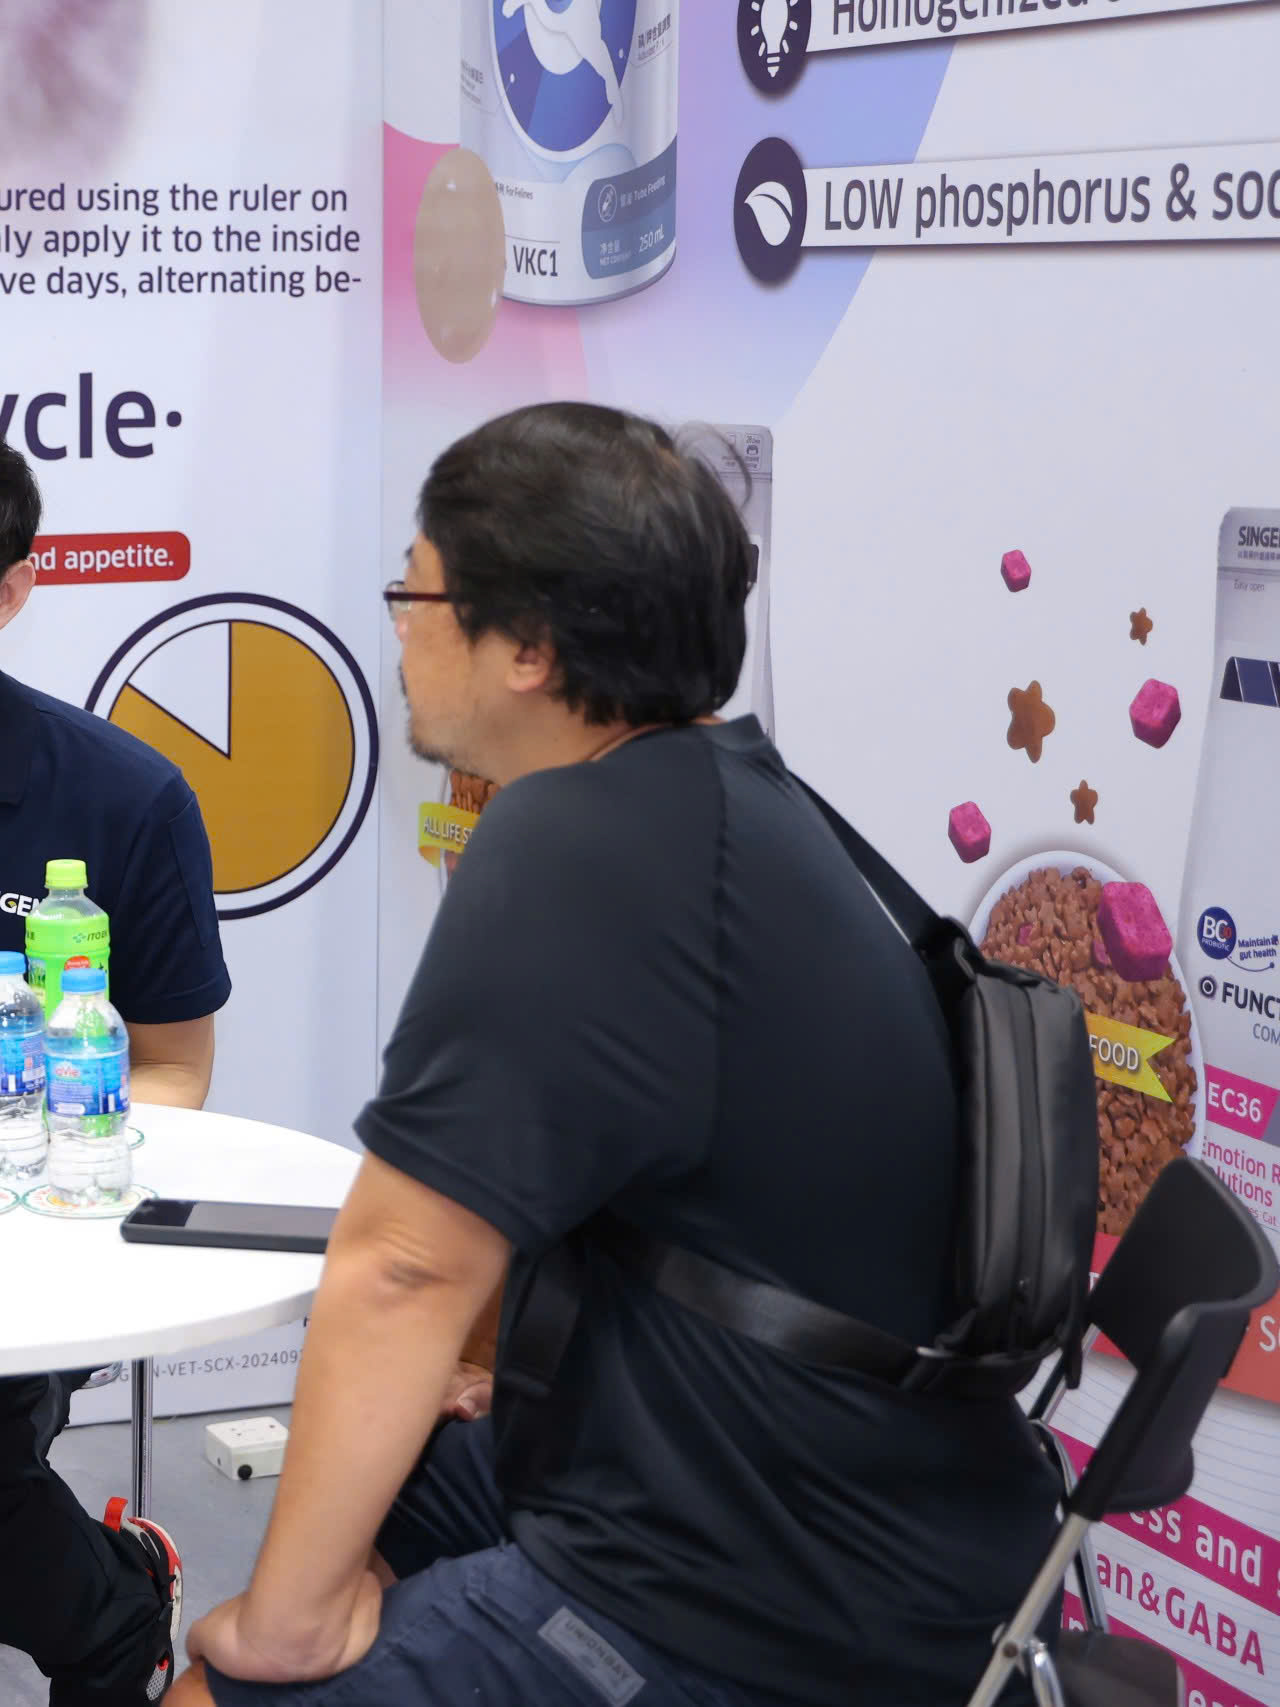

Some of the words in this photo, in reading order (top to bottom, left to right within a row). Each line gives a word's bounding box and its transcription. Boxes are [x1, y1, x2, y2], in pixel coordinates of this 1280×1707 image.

[77, 182, 160, 217] using
[169, 183, 218, 212] the
[229, 183, 302, 212] ruler
[311, 189, 348, 212] on
[823, 177, 903, 231] LOW
[916, 168, 1150, 238] phosphorus
[1165, 162, 1197, 222] &
[43, 224, 131, 258] apply
[142, 224, 163, 253] it
[172, 225, 202, 253] to
[212, 224, 261, 253] the
[272, 223, 361, 253] inside
[639, 231, 653, 252] 250
[513, 244, 559, 278] VKC1
[46, 265, 127, 300] days,
[138, 264, 305, 298] alternating
[315, 264, 362, 293] be-
[1237, 525, 1280, 549] SINGE
[28, 546, 57, 572] nd
[63, 543, 175, 574] appetite.
[1221, 981, 1280, 1022] FUNC
[1088, 1034, 1139, 1070] FOOD
[1207, 1081, 1262, 1123] EC36
[1194, 1523, 1263, 1588] and
